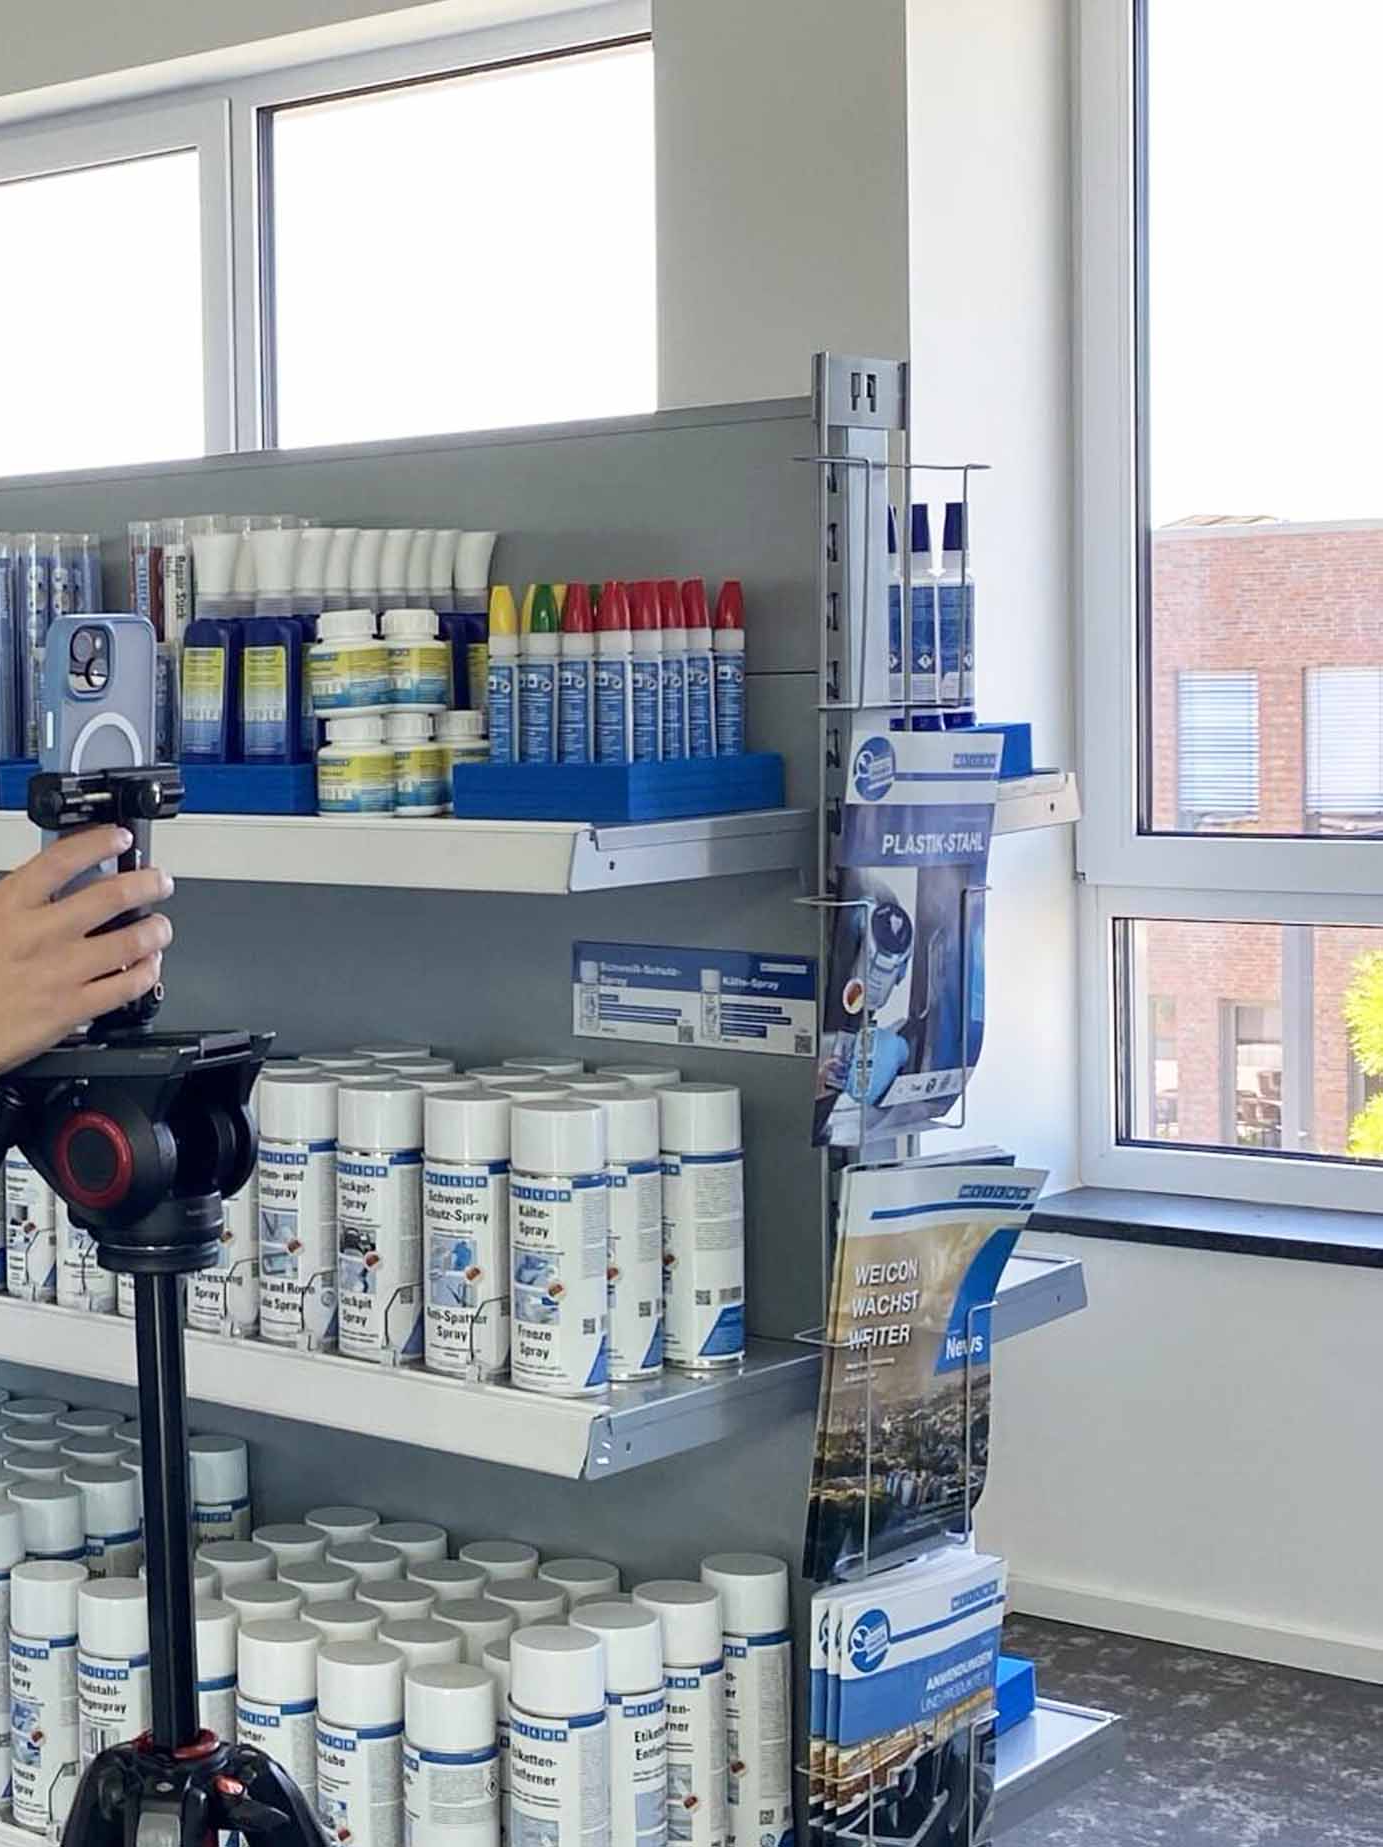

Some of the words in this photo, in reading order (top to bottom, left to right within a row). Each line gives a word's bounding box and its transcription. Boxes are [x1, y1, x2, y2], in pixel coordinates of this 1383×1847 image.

[881, 831, 985, 855] PLASTIK-STAHL
[519, 1222, 549, 1239] Spray
[855, 1258, 919, 1287] WEICON
[436, 1325, 468, 1342] Spray
